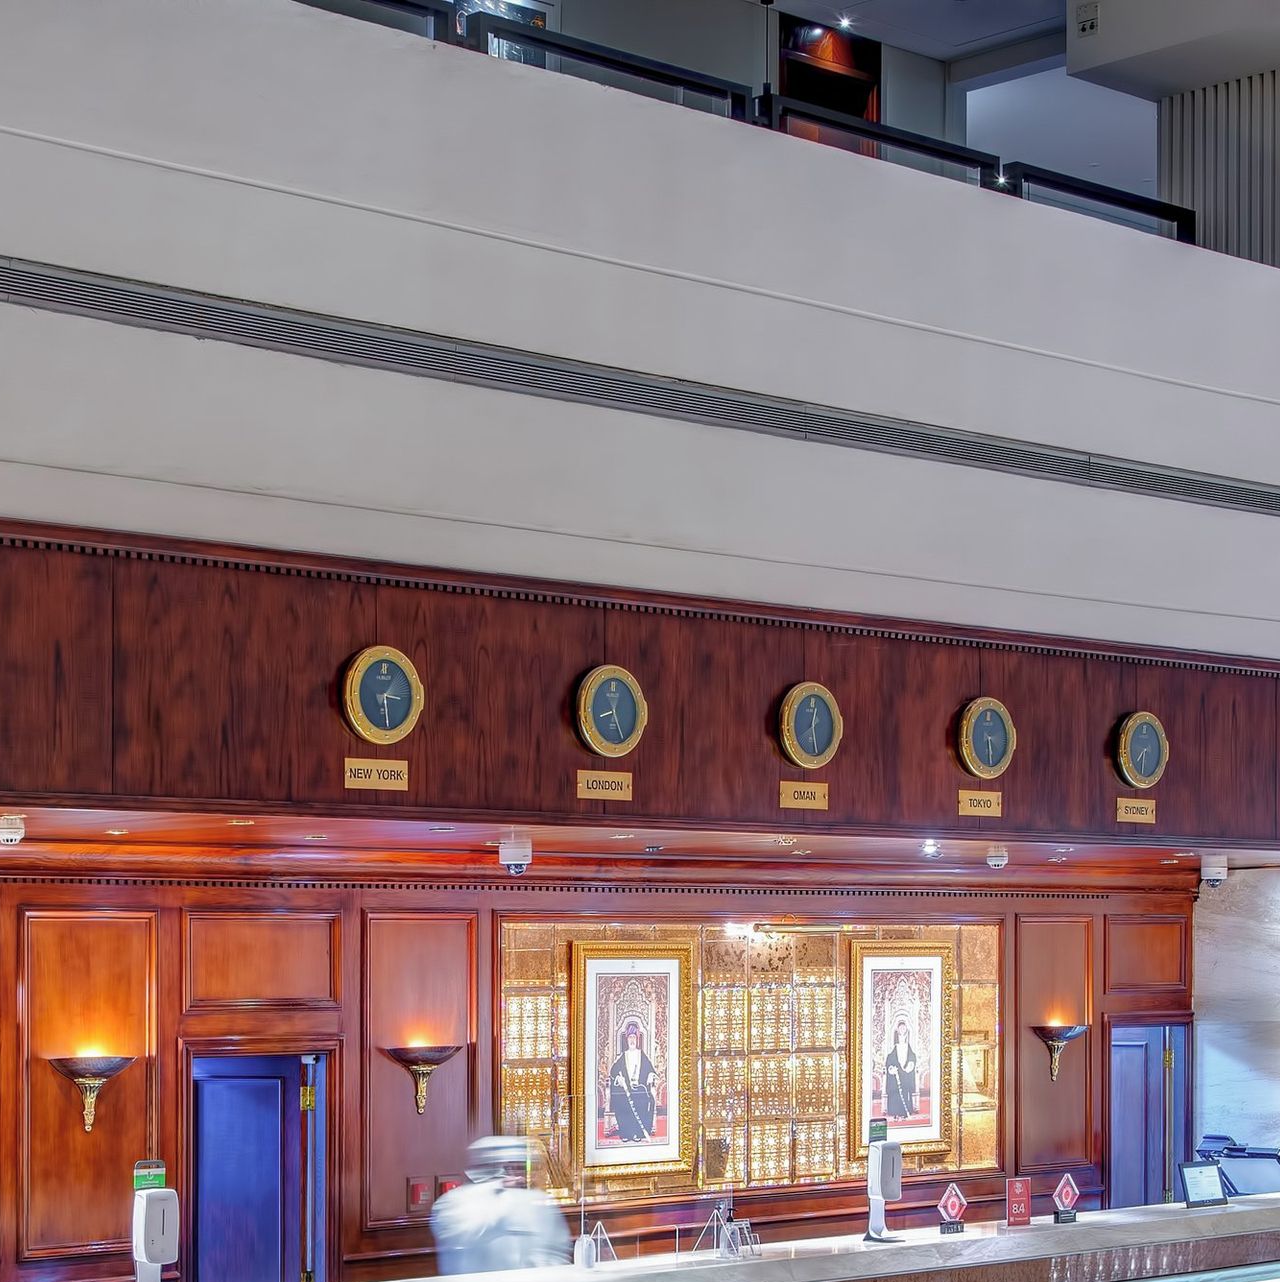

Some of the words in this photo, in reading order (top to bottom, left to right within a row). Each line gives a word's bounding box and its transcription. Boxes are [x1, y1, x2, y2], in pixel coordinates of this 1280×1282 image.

[349, 768, 372, 779] NEW
[376, 769, 403, 780] YORK
[586, 779, 623, 791] LONDON
[793, 790, 816, 800] OMAN
[969, 798, 992, 808] TOKYO
[1124, 805, 1149, 815] SYDNEY
